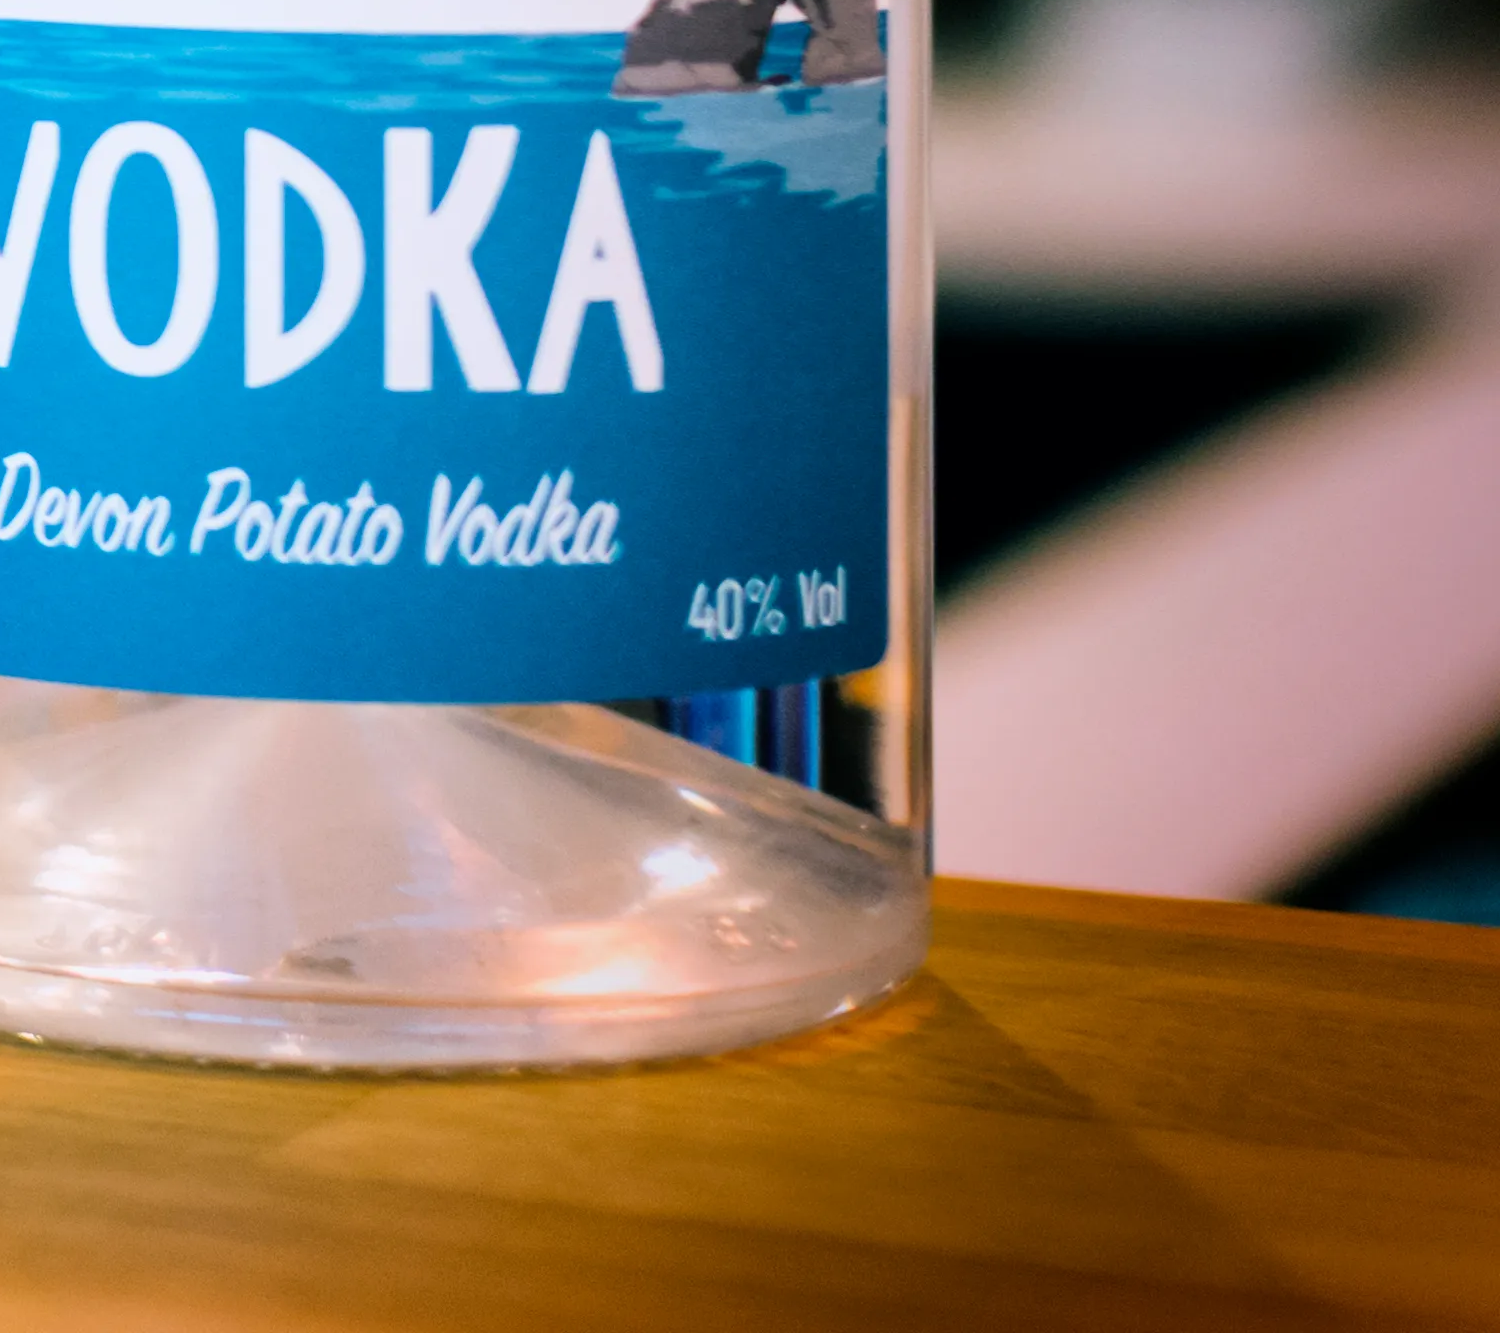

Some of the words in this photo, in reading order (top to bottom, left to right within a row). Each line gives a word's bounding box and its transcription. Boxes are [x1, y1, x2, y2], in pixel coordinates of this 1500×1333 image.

[191, 467, 402, 566] Potato
[424, 467, 623, 567] Vodka
[687, 575, 786, 641] 40%
[798, 564, 846, 629] Vol
